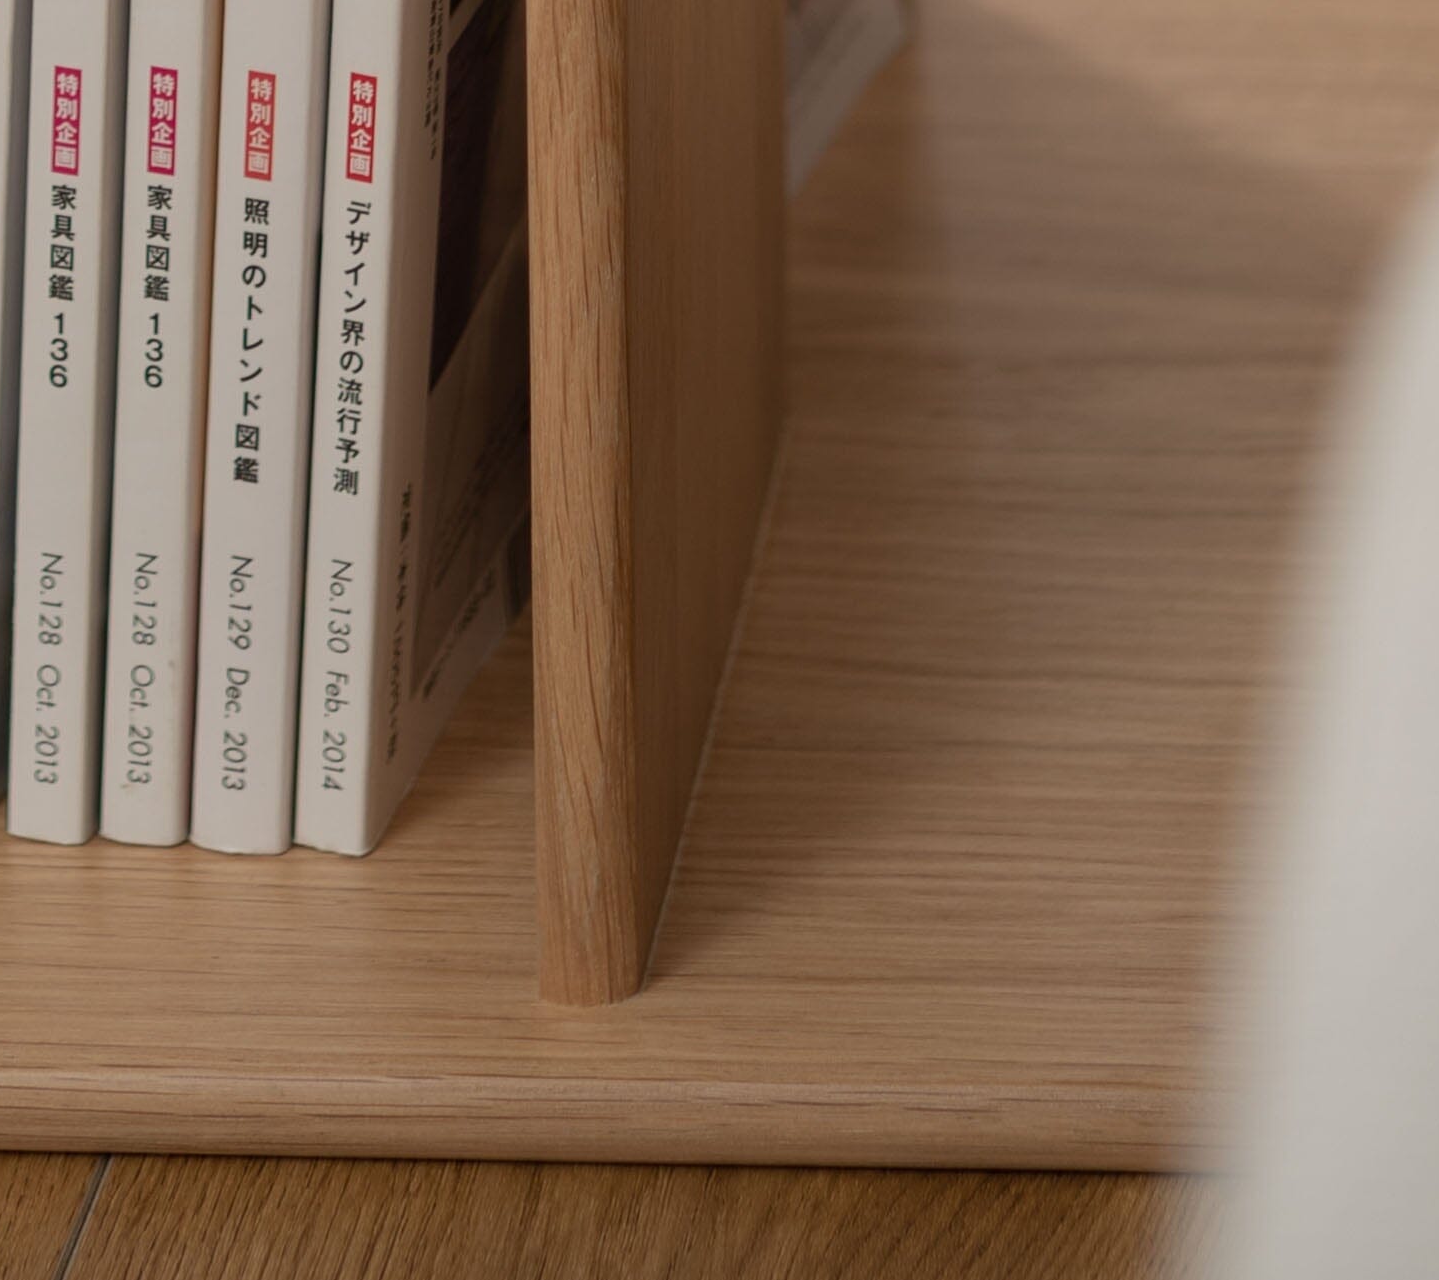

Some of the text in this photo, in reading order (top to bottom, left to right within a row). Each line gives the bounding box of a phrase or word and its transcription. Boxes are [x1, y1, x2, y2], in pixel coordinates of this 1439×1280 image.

[53, 72, 78, 170] 特別企画
[149, 72, 175, 171] 特別企画
[247, 76, 273, 175] 特別企画
[349, 78, 374, 177] 特別企画
[33, 552, 64, 785] No.128 Oct. 2013
[126, 552, 159, 784] No.128 Oct. 2013
[221, 554, 254, 791] No.129 Dec. 2013
[322, 558, 353, 791] No.130 Feb. 2014
